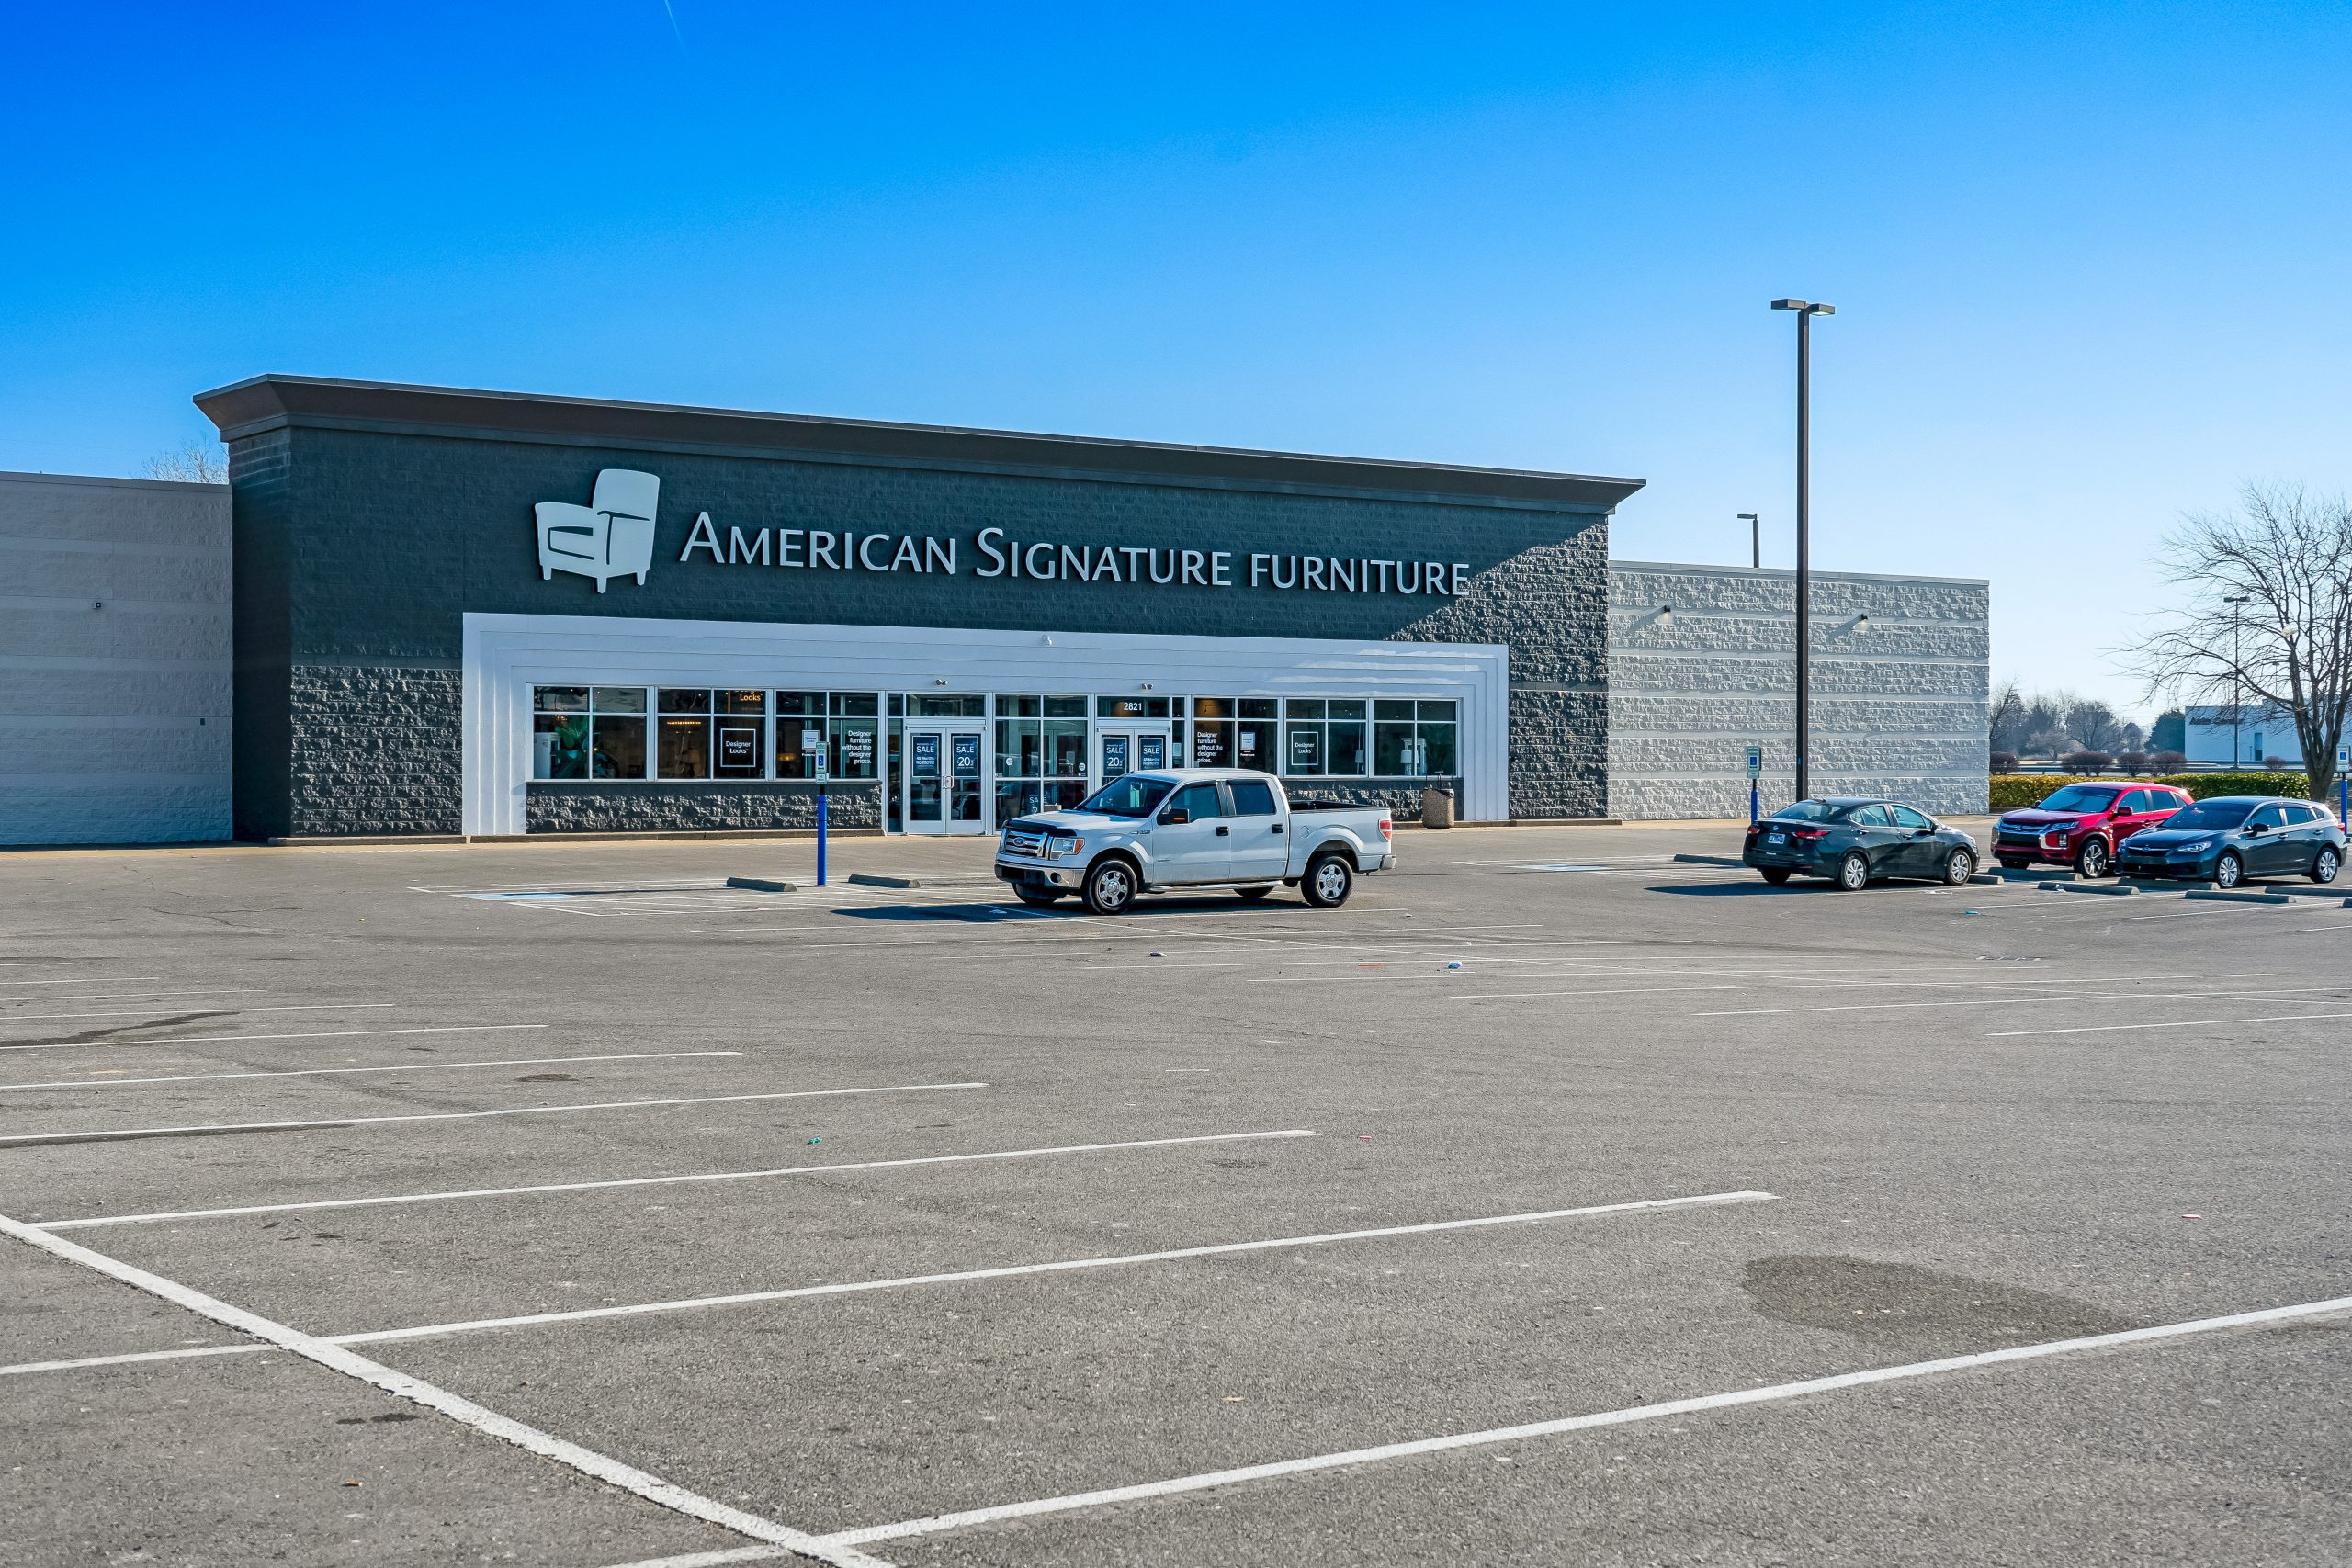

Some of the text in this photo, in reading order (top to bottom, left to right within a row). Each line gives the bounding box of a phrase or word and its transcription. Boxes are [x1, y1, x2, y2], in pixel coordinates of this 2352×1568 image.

[679, 511, 1470, 596] AMERICAN SIGNATURE FURNITURE
[1124, 703, 1142, 711] 2821
[848, 730, 872, 739] Designer
[725, 740, 752, 749] Designer
